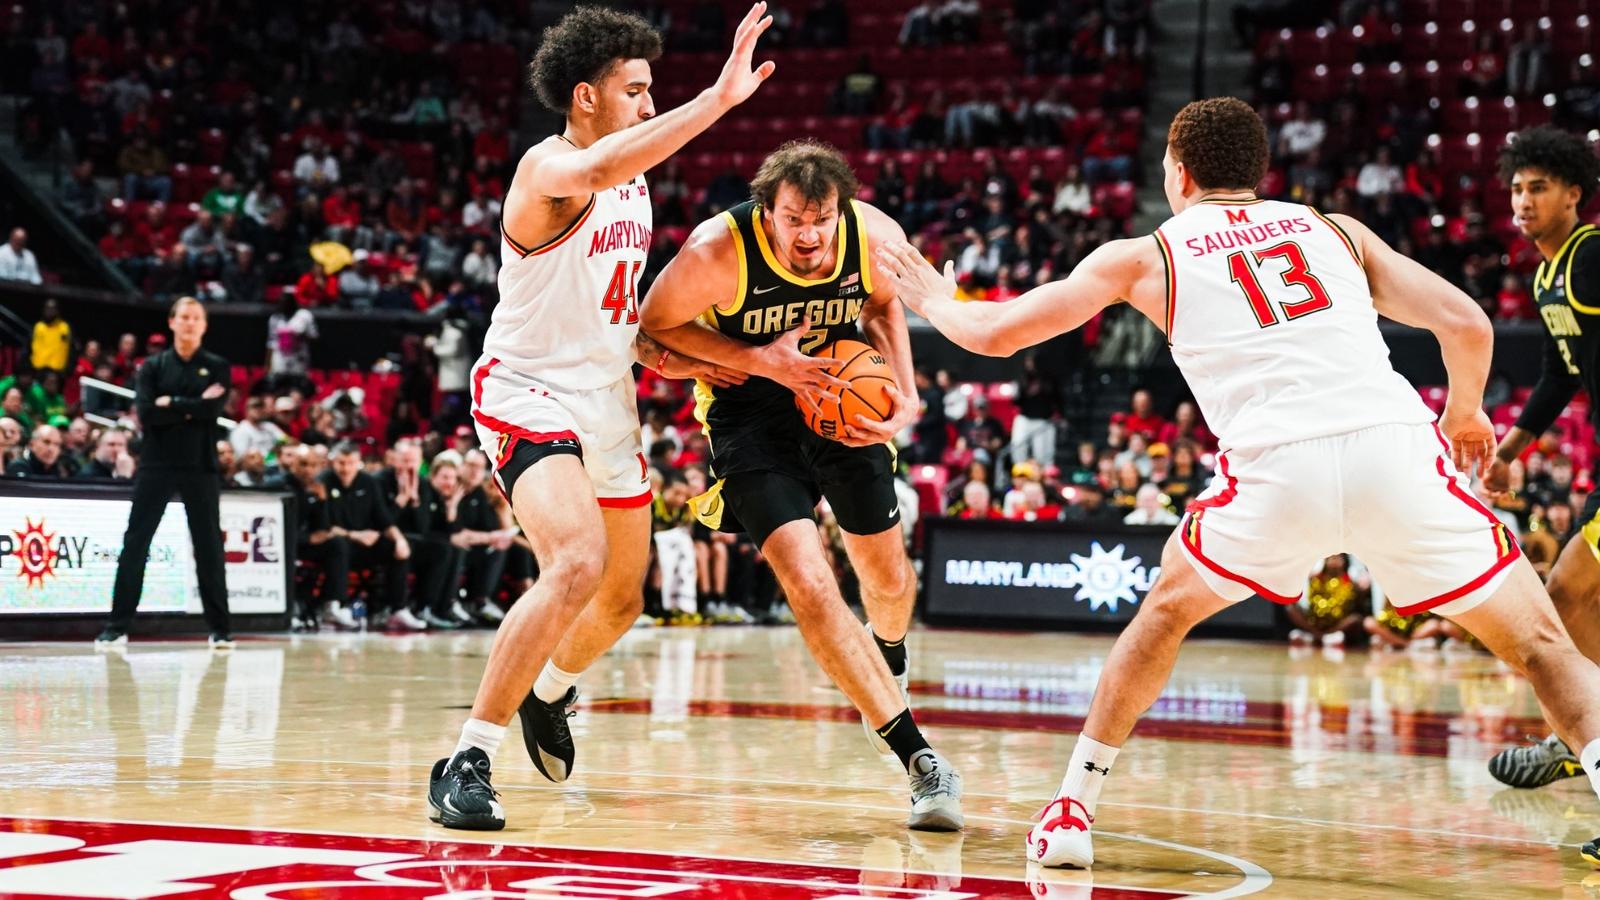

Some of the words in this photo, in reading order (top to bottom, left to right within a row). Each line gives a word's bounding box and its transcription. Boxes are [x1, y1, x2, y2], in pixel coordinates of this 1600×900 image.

[1224, 208, 1253, 225] M
[587, 220, 652, 258] MARYLAN
[1186, 218, 1312, 257] SAUNDERS
[601, 261, 640, 324] 45
[1227, 240, 1333, 329] 13
[743, 298, 863, 334] OREGON
[945, 559, 1078, 589] MARYLAND
